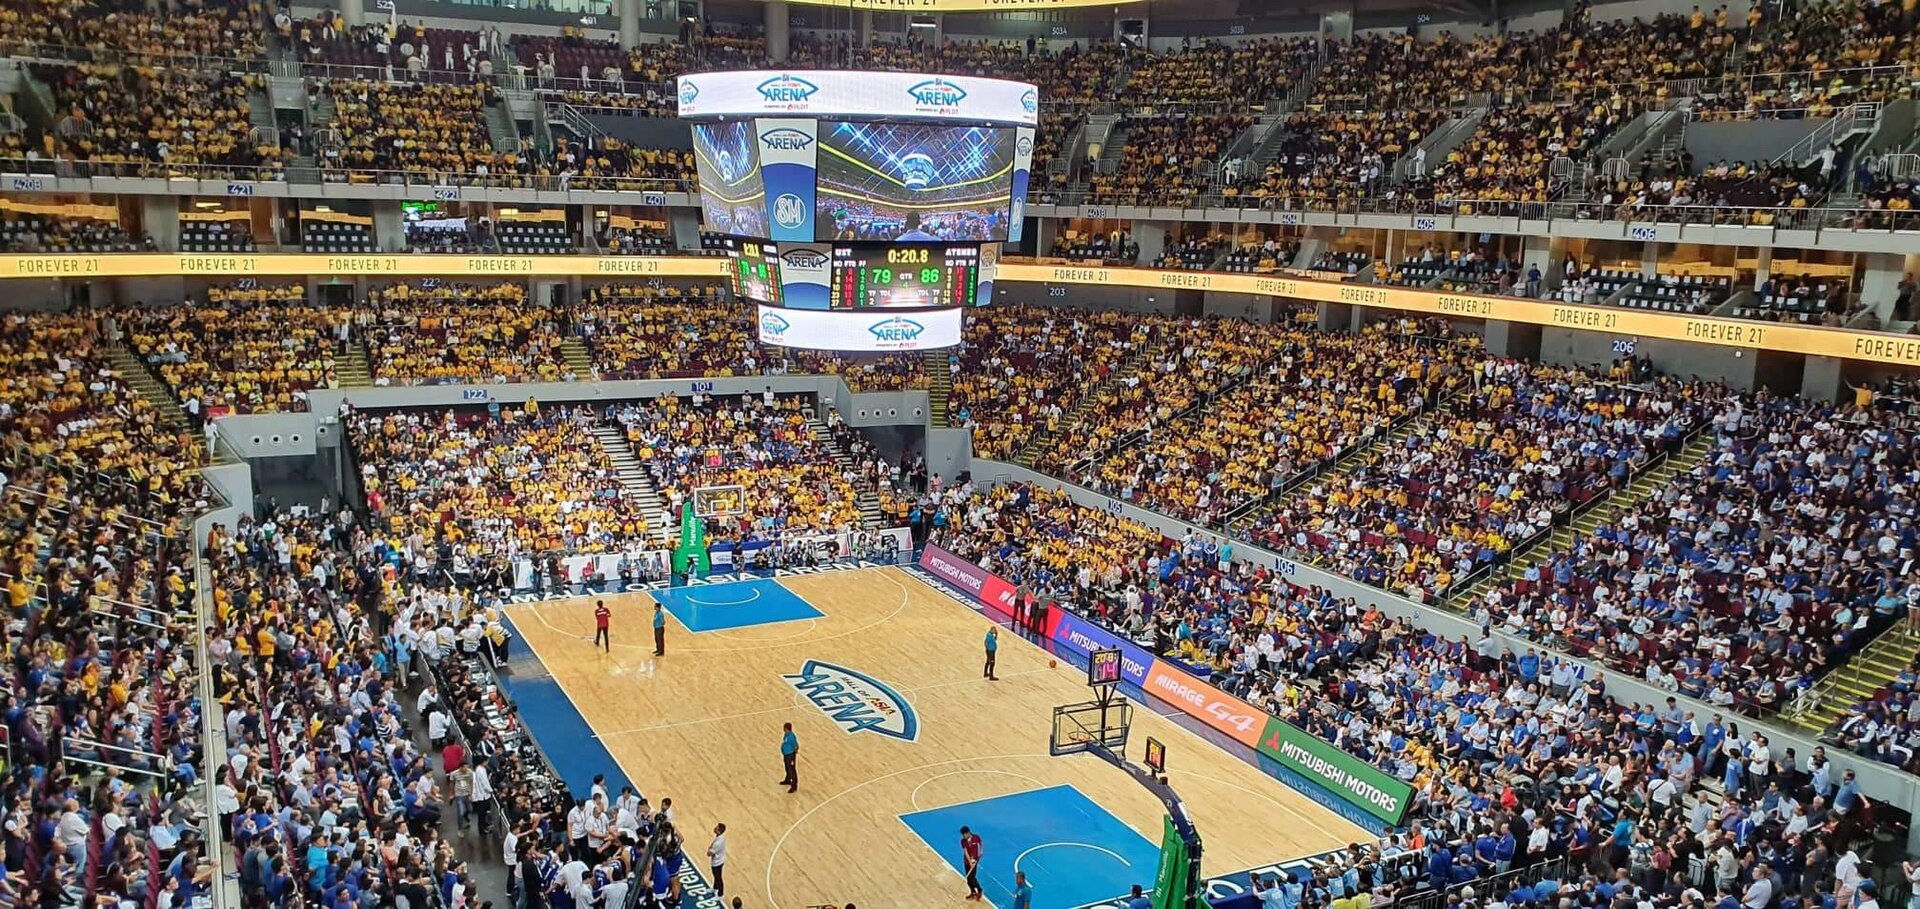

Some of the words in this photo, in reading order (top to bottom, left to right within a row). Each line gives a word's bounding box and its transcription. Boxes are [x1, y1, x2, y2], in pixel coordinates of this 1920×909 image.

[1052, 26, 1067, 35] 503A
[764, 88, 808, 102] ARENA
[916, 91, 958, 106] ARENA
[768, 138, 806, 150] ARENA
[229, 185, 252, 195] 421
[776, 198, 801, 224] SM
[1282, 215, 1297, 224] 404
[1418, 220, 1435, 230] 405
[1633, 228, 1656, 240] 406
[787, 257, 822, 268] ARENA
[888, 249, 929, 264] 0:20.8
[19, 260, 78, 272] FOREVER
[86, 259, 99, 271] 21
[181, 259, 236, 270] FOREVER
[243, 259, 256, 270] 21
[329, 259, 380, 270] FOREVER
[386, 260, 397, 270] 21
[469, 260, 512, 270] FOREVER
[521, 260, 532, 270] 21
[599, 260, 643, 272] FOREVER
[648, 262, 658, 272] 21
[872, 268, 892, 284] 79
[920, 268, 940, 283] 86
[1054, 269, 1094, 280] FOREVER
[1098, 270, 1108, 281] 21
[1162, 274, 1198, 286] FOREVER
[1202, 277, 1211, 288] 21
[1050, 288, 1066, 296] 203
[1257, 280, 1288, 292] FOREVER
[1288, 283, 1296, 294] 21
[1341, 288, 1376, 302] FOREVER
[1378, 292, 1387, 304] 21
[1438, 298, 1478, 312] FOREVER
[1482, 302, 1492, 314] 21
[1554, 308, 1600, 326] FOREVER
[1605, 314, 1616, 328] 21
[877, 328, 917, 340] ARENA
[1687, 321, 1744, 340] FOREVER
[1748, 328, 1762, 344] 21
[1613, 340, 1634, 353] 206
[466, 390, 487, 399] 122
[1109, 500, 1122, 513] 105
[1277, 559, 1295, 574] 106
[930, 557, 960, 580] MITSUBISHI
[959, 571, 982, 590] MOTORS
[1102, 663, 1116, 680] 14
[783, 674, 886, 732] ARENA
[1154, 674, 1206, 707] MIRAGE
[1205, 701, 1257, 732] G4
[1280, 740, 1346, 786] MITSUBISHI
[1344, 774, 1398, 812] MOTORS
